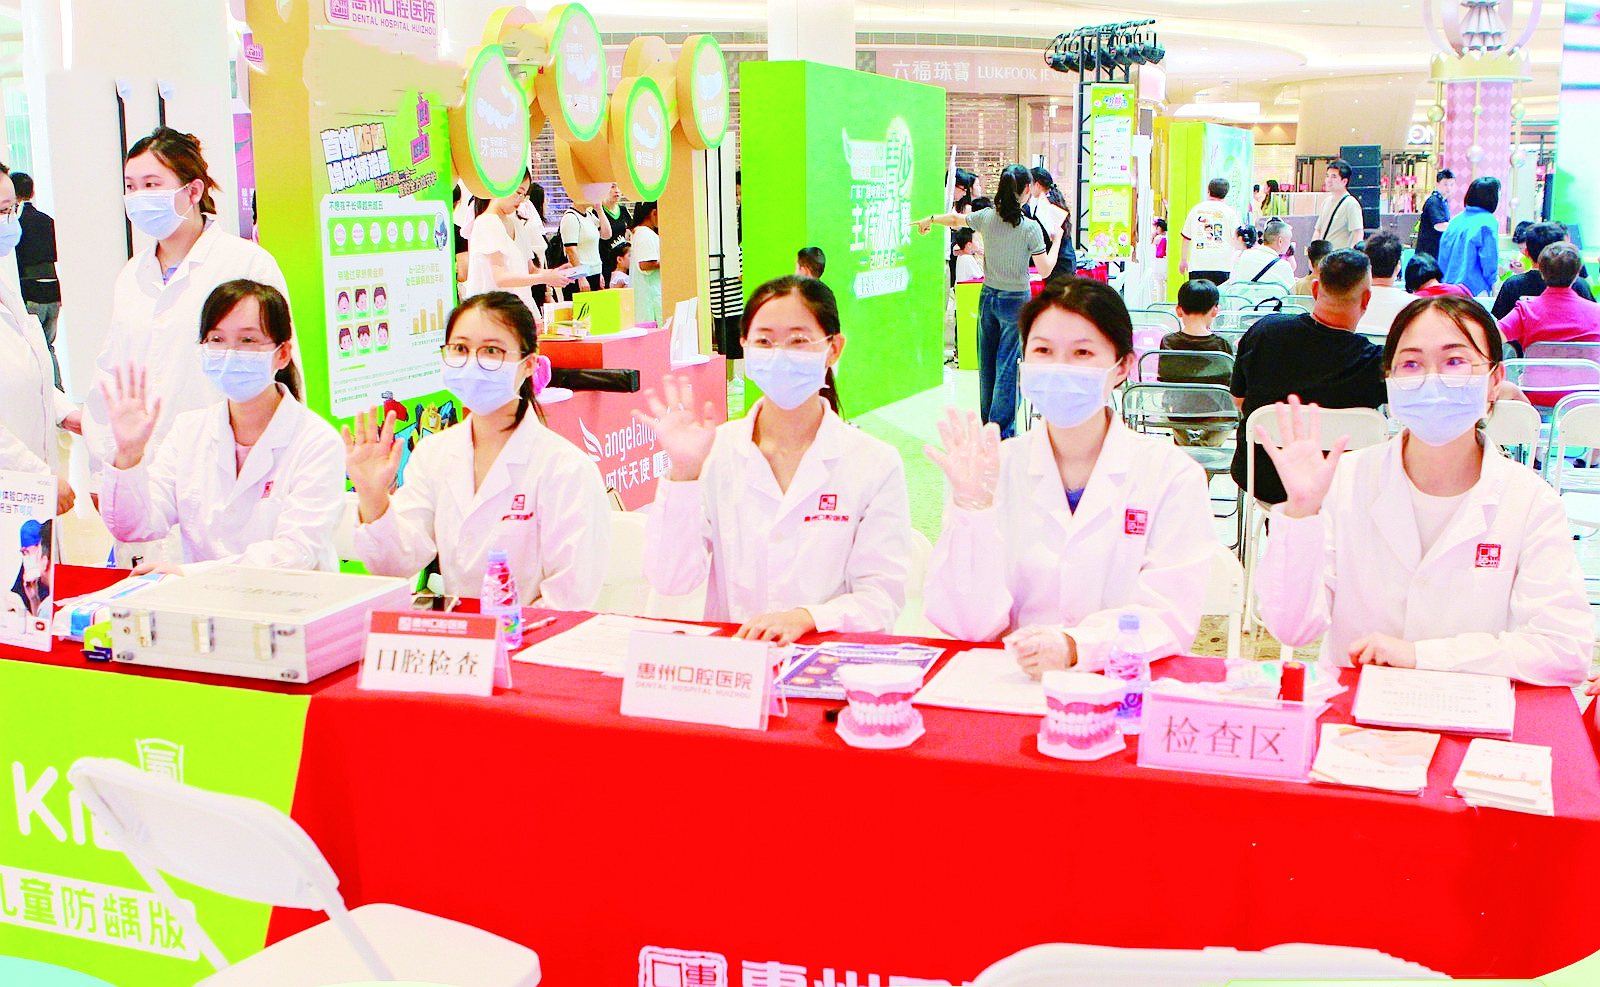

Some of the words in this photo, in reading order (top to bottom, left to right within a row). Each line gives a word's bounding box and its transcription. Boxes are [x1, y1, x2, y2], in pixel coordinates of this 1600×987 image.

[352, 13, 379, 26] DENTAL
[381, 19, 410, 32] HOSPITAL
[412, 25, 437, 36] HUIZHOU
[892, 59, 971, 82] 六福珠寶
[977, 65, 1037, 80] LUKFOOK
[606, 457, 650, 492] 时代天使
[376, 649, 479, 677] 口腔检查
[637, 662, 752, 690] 惠州口腔医院
[1162, 715, 1286, 762] 检查区
